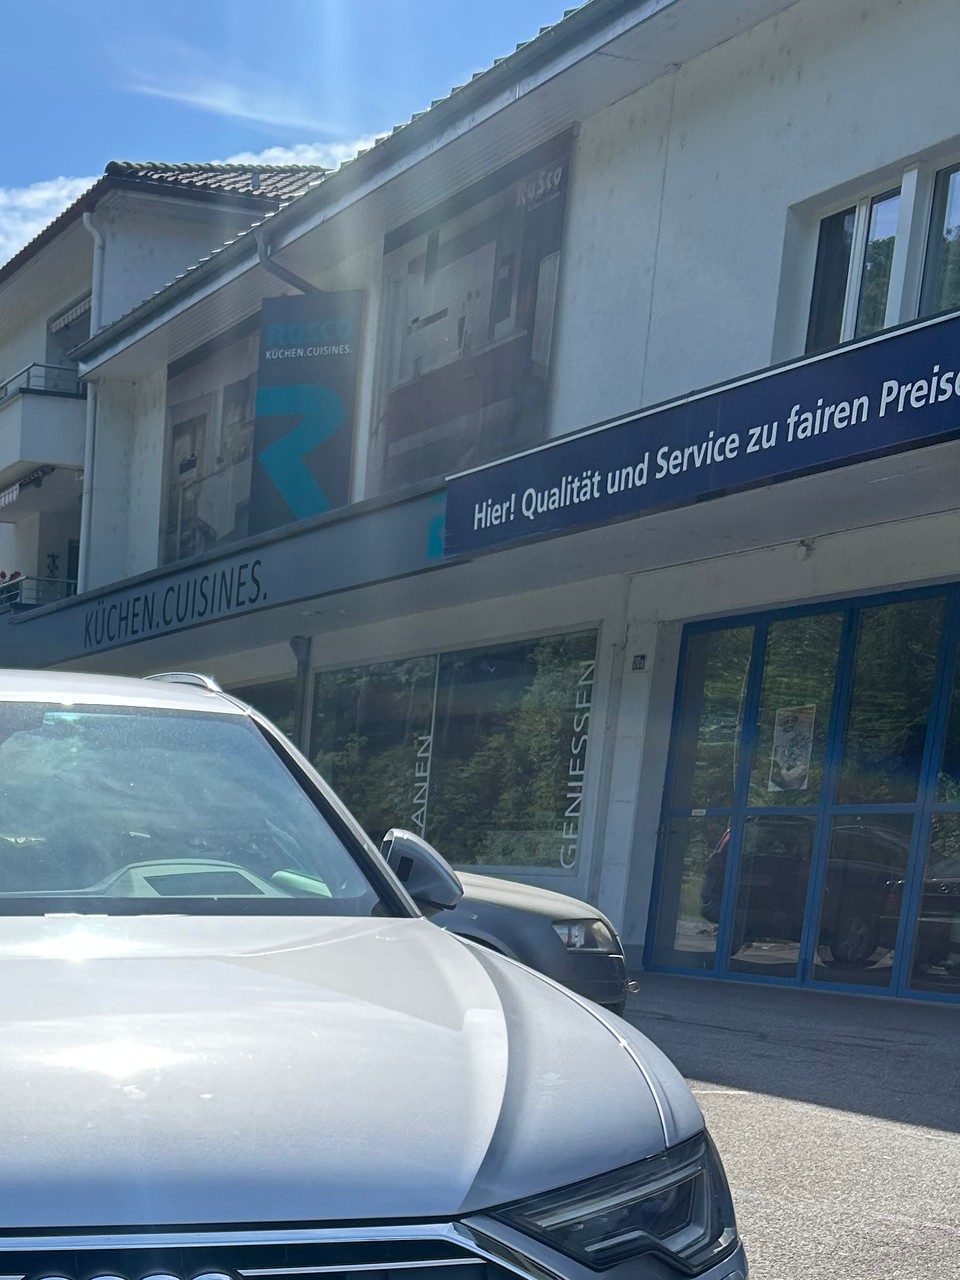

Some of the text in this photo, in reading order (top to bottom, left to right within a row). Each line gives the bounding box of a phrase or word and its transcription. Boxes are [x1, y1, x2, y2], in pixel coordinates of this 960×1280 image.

[473, 364, 960, 531] Hier! Qualität und Service zu fairen Preis
[84, 559, 269, 649] KÜCHEN.CUISINES.
[560, 660, 596, 870] GENIESSEN
